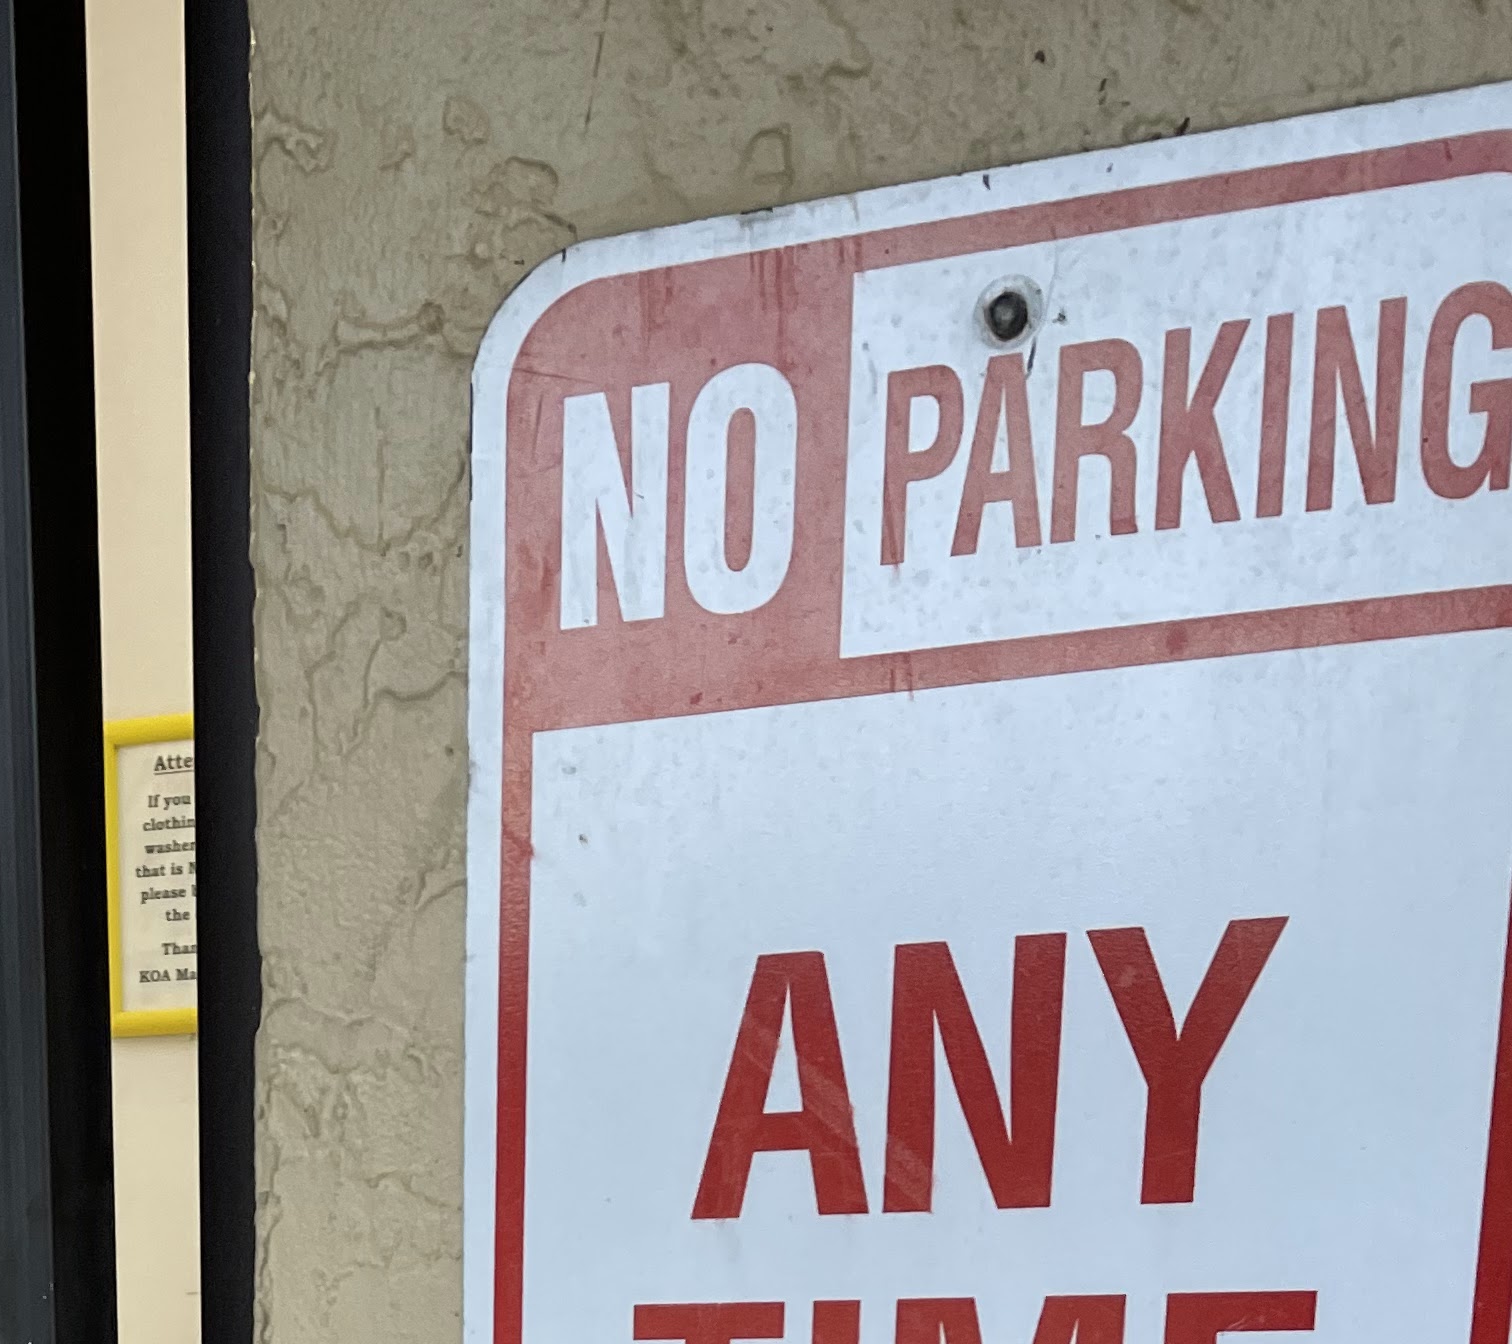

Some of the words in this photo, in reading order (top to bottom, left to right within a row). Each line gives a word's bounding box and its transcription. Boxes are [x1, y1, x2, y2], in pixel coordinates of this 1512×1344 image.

[560, 362, 798, 631] NO
[880, 280, 1512, 565] PARKING
[148, 794, 160, 807] If
[163, 794, 191, 810] you
[135, 863, 166, 878] that
[171, 862, 183, 875] is
[140, 887, 187, 904] please
[165, 908, 191, 921] the
[138, 969, 171, 983] KOA
[690, 915, 1290, 1220] ANY
